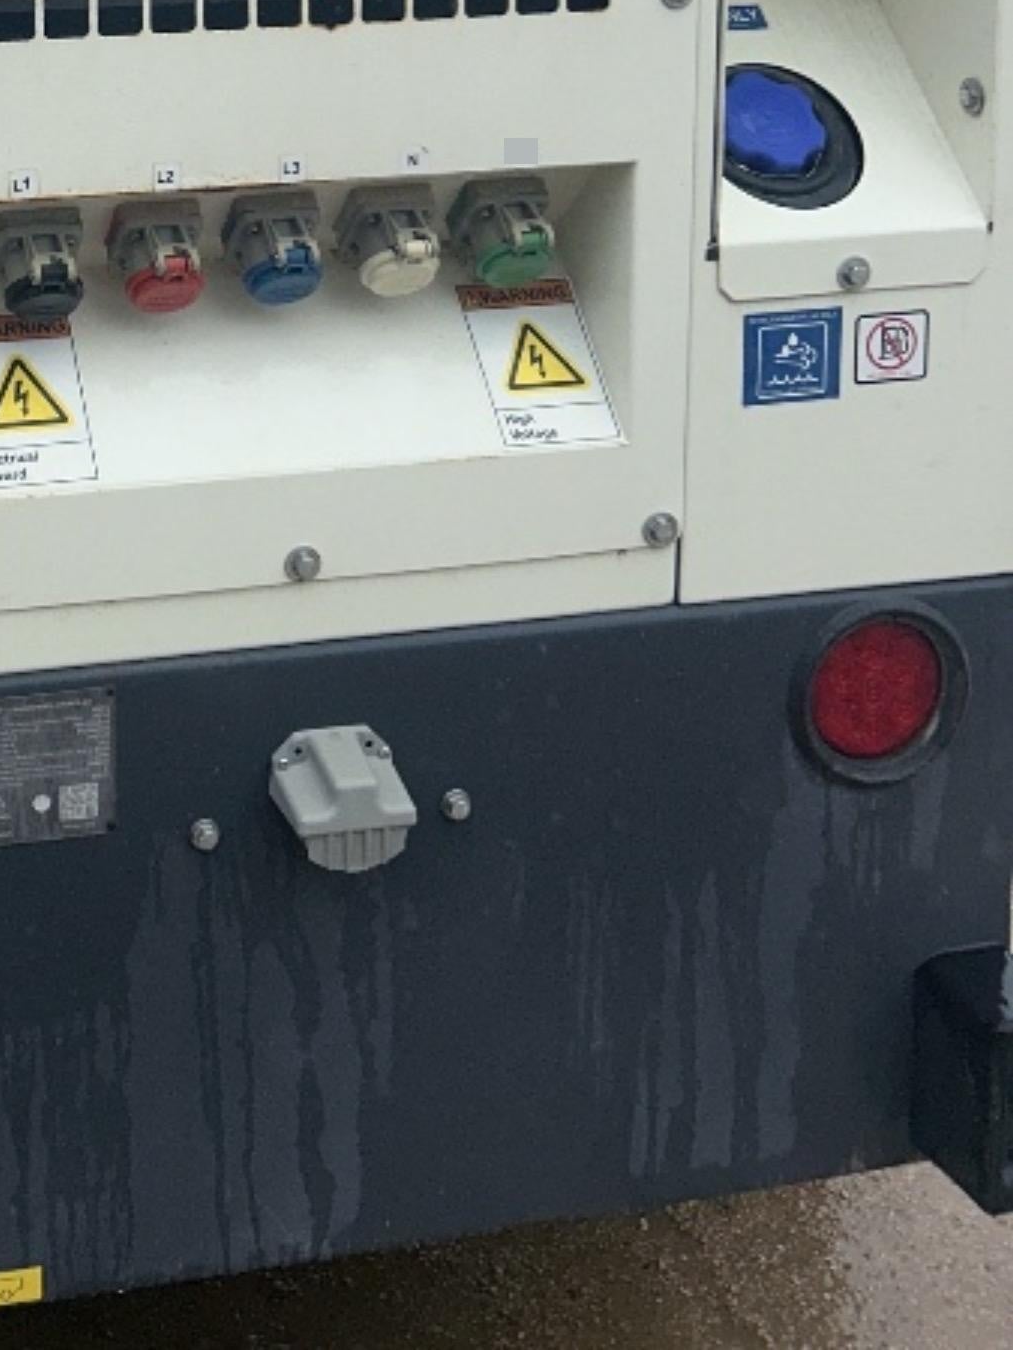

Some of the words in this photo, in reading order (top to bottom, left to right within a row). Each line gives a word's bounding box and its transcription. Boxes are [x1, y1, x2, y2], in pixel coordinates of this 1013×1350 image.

[283, 161, 300, 175] L3
[157, 170, 174, 184] L2
[13, 177, 30, 192] L1
